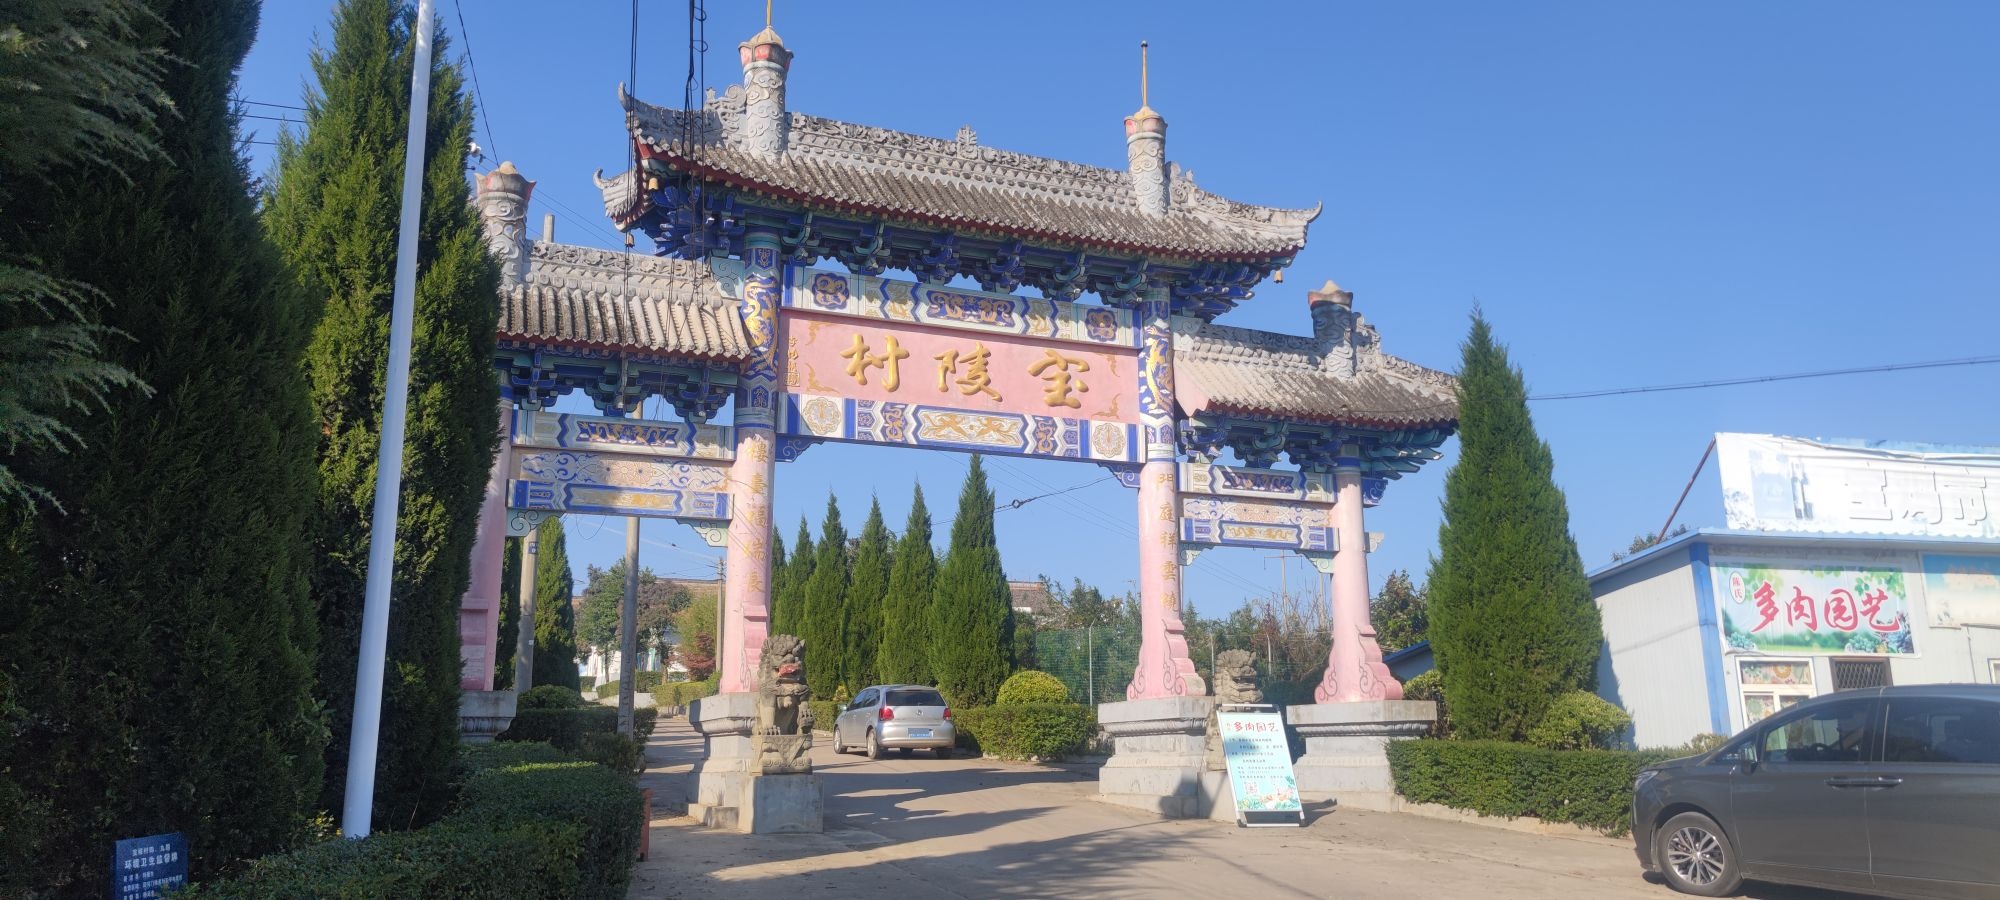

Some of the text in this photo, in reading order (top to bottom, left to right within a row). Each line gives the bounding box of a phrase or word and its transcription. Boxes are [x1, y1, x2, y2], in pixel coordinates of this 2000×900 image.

[1751, 580, 1901, 633] 多肉园艺
[1233, 721, 1276, 733] 多肉园艺
